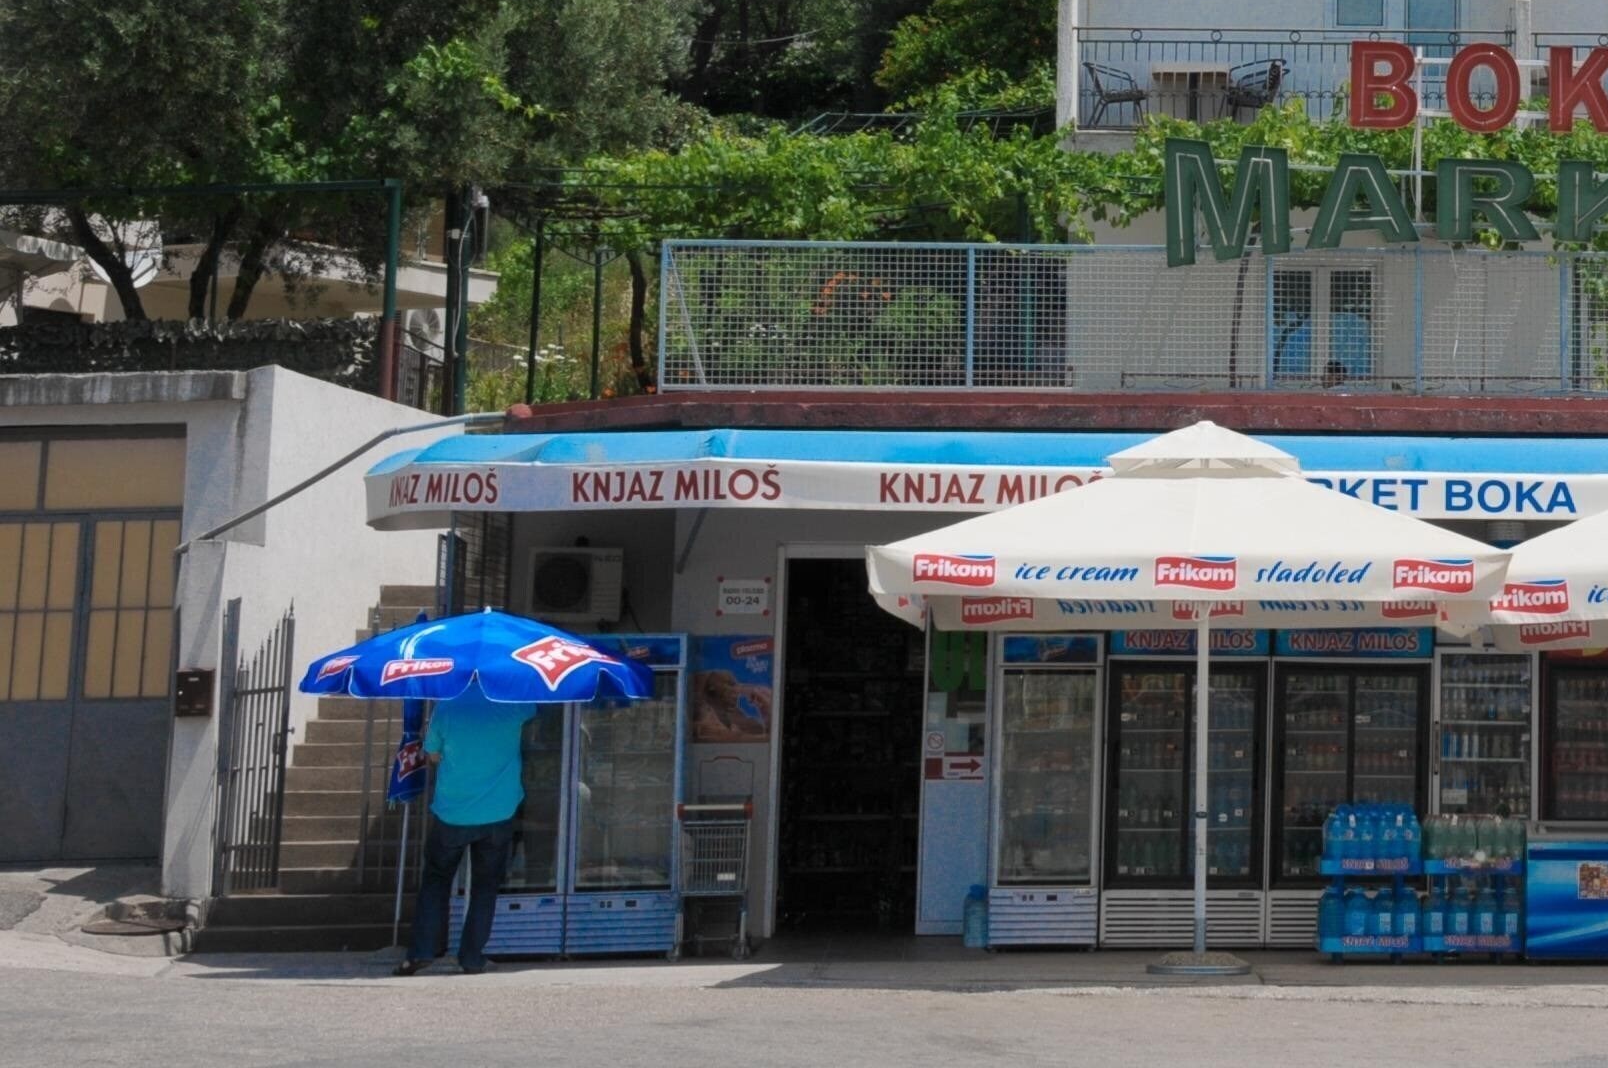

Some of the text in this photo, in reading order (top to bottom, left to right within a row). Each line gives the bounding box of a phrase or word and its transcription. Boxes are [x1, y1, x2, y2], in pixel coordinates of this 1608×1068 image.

[425, 468, 498, 503] MILOŠ
[572, 464, 781, 503] KNJAZ MILOŠ
[880, 472, 984, 504] KNJAZ
[1444, 479, 1577, 513] BOKA
[916, 559, 992, 578] Frikom
[1015, 562, 1138, 581] ice cream
[1157, 563, 1234, 582] Frikom
[1255, 561, 1373, 584] sladoled
[1395, 565, 1471, 584] Frikom
[1125, 630, 1255, 649] KNJAZ ILOŠ
[1289, 632, 1352, 650] KNJAZ
